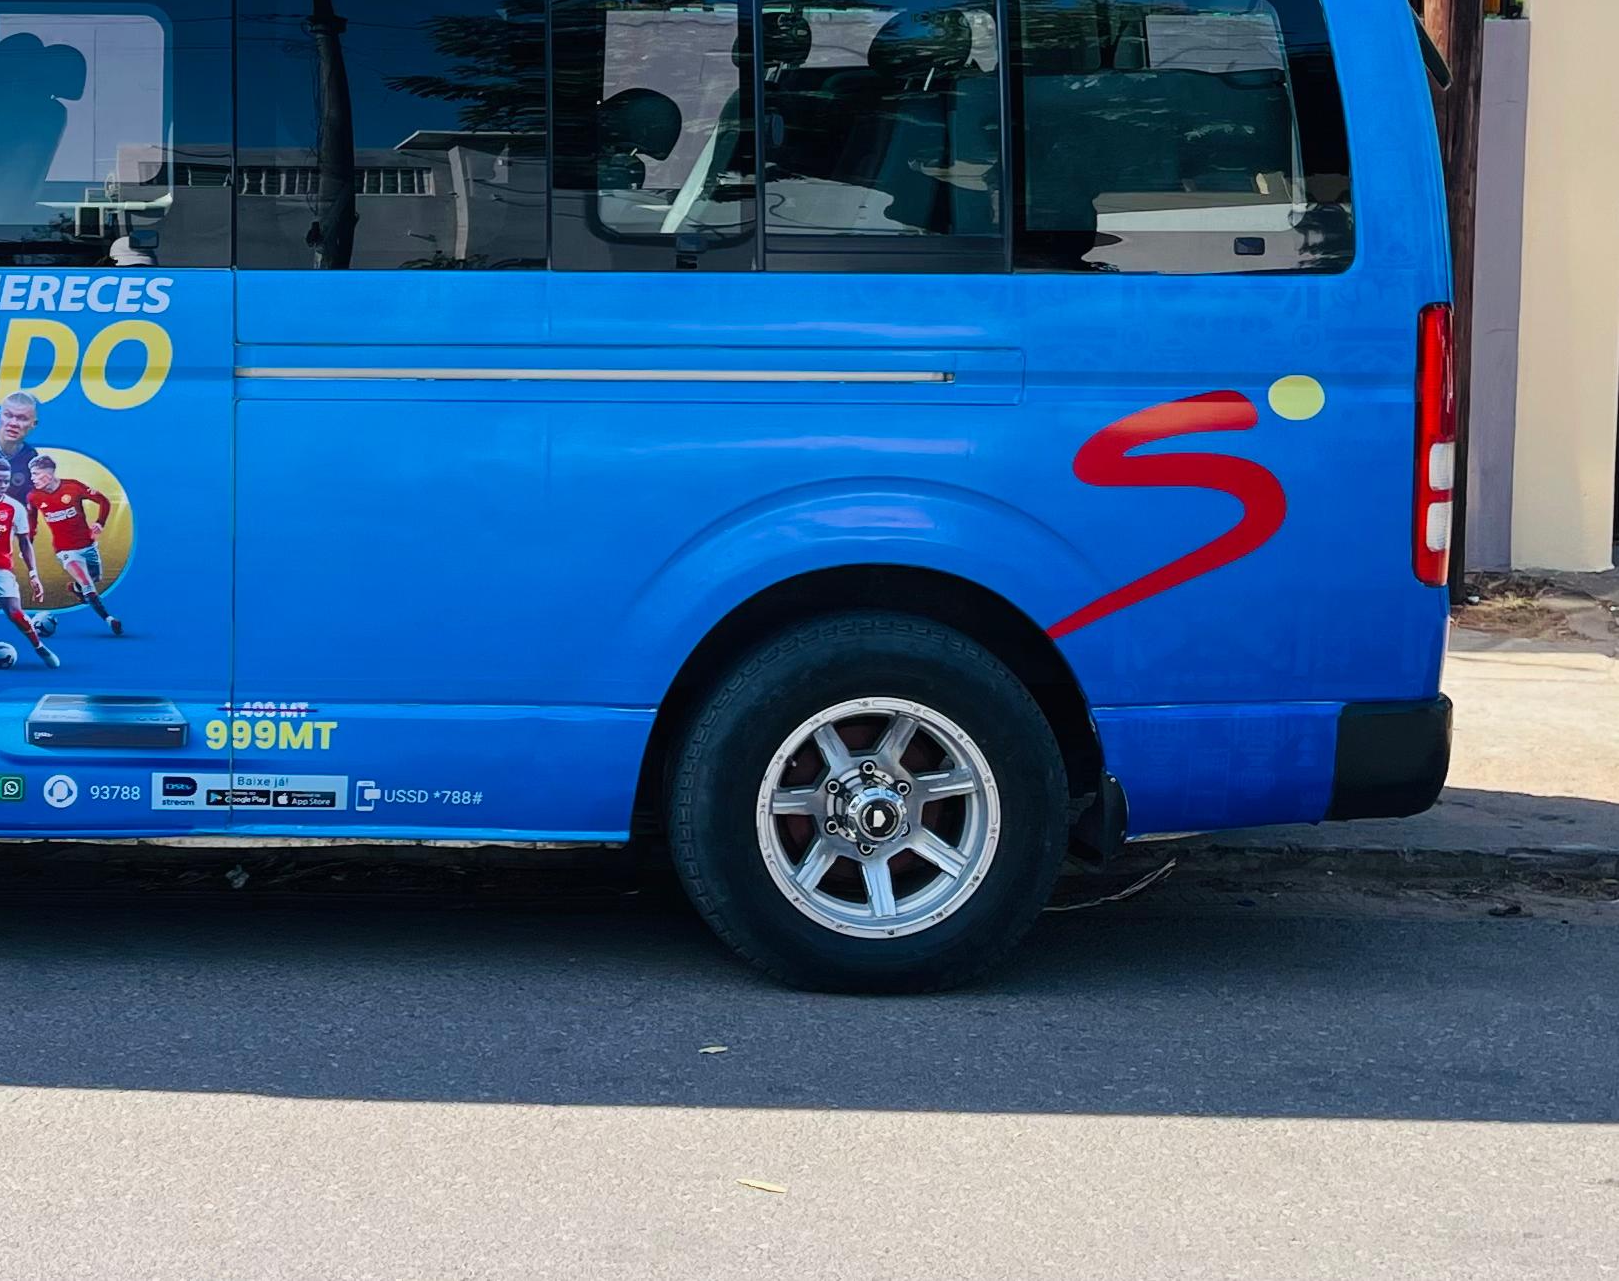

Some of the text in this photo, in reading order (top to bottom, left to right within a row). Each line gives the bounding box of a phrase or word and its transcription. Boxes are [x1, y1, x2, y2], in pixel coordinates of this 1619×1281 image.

[205, 719, 338, 750] 999MT
[237, 776, 289, 788] Baixe já!
[90, 785, 140, 800] 93788
[384, 789, 429, 803] USSD
[162, 798, 195, 806] stream
[291, 797, 331, 806] App Store
